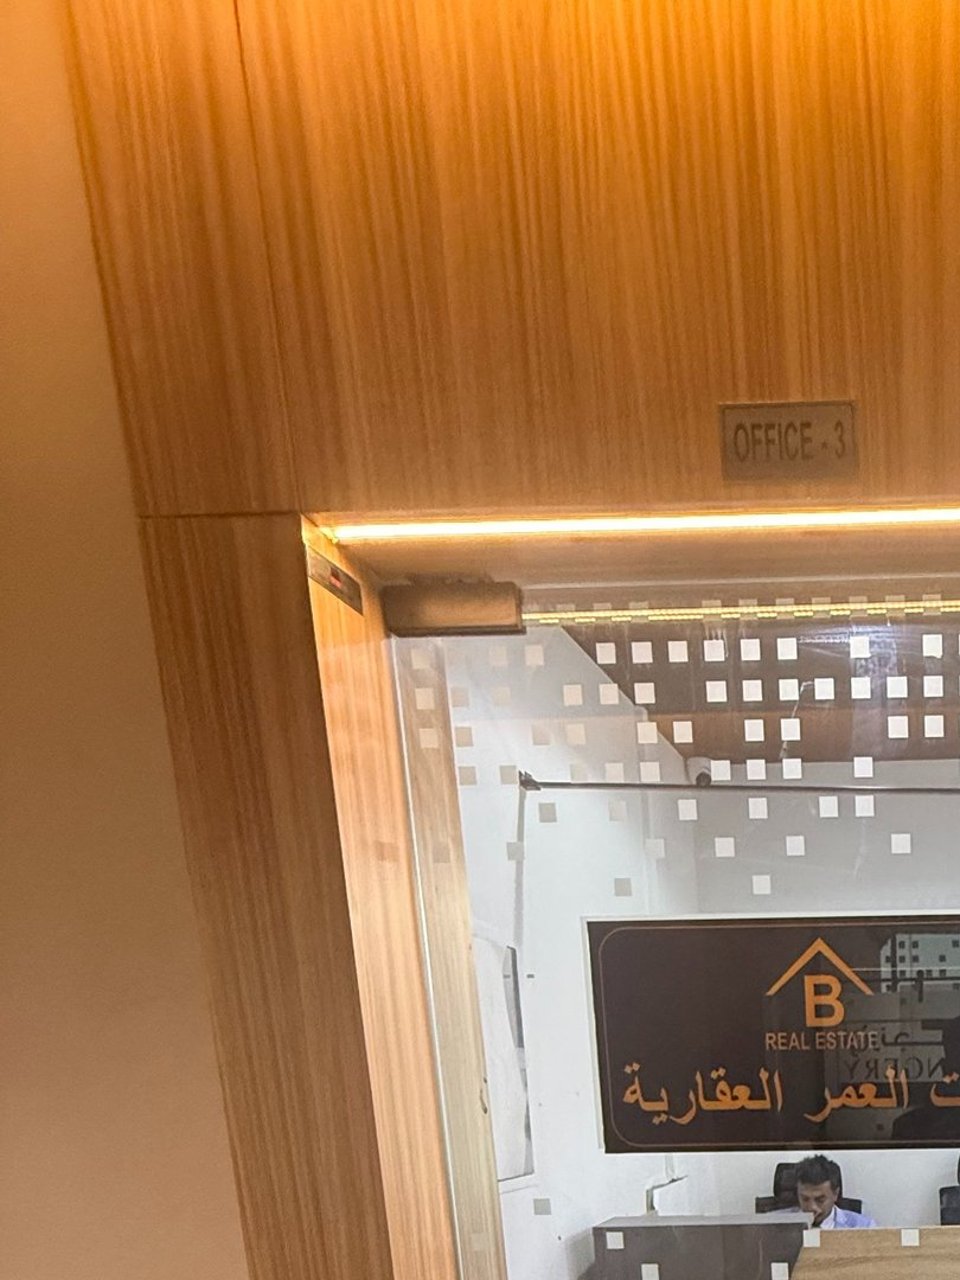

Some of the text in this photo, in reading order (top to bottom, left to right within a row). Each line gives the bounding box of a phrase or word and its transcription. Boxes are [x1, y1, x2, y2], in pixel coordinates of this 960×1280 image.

[804, 973, 846, 1028] B
[765, 1031, 810, 1051] REAL
[815, 1031, 879, 1050] ESTATE
[621, 1061, 784, 1126] العقارية
[802, 1064, 910, 1123] العمر
